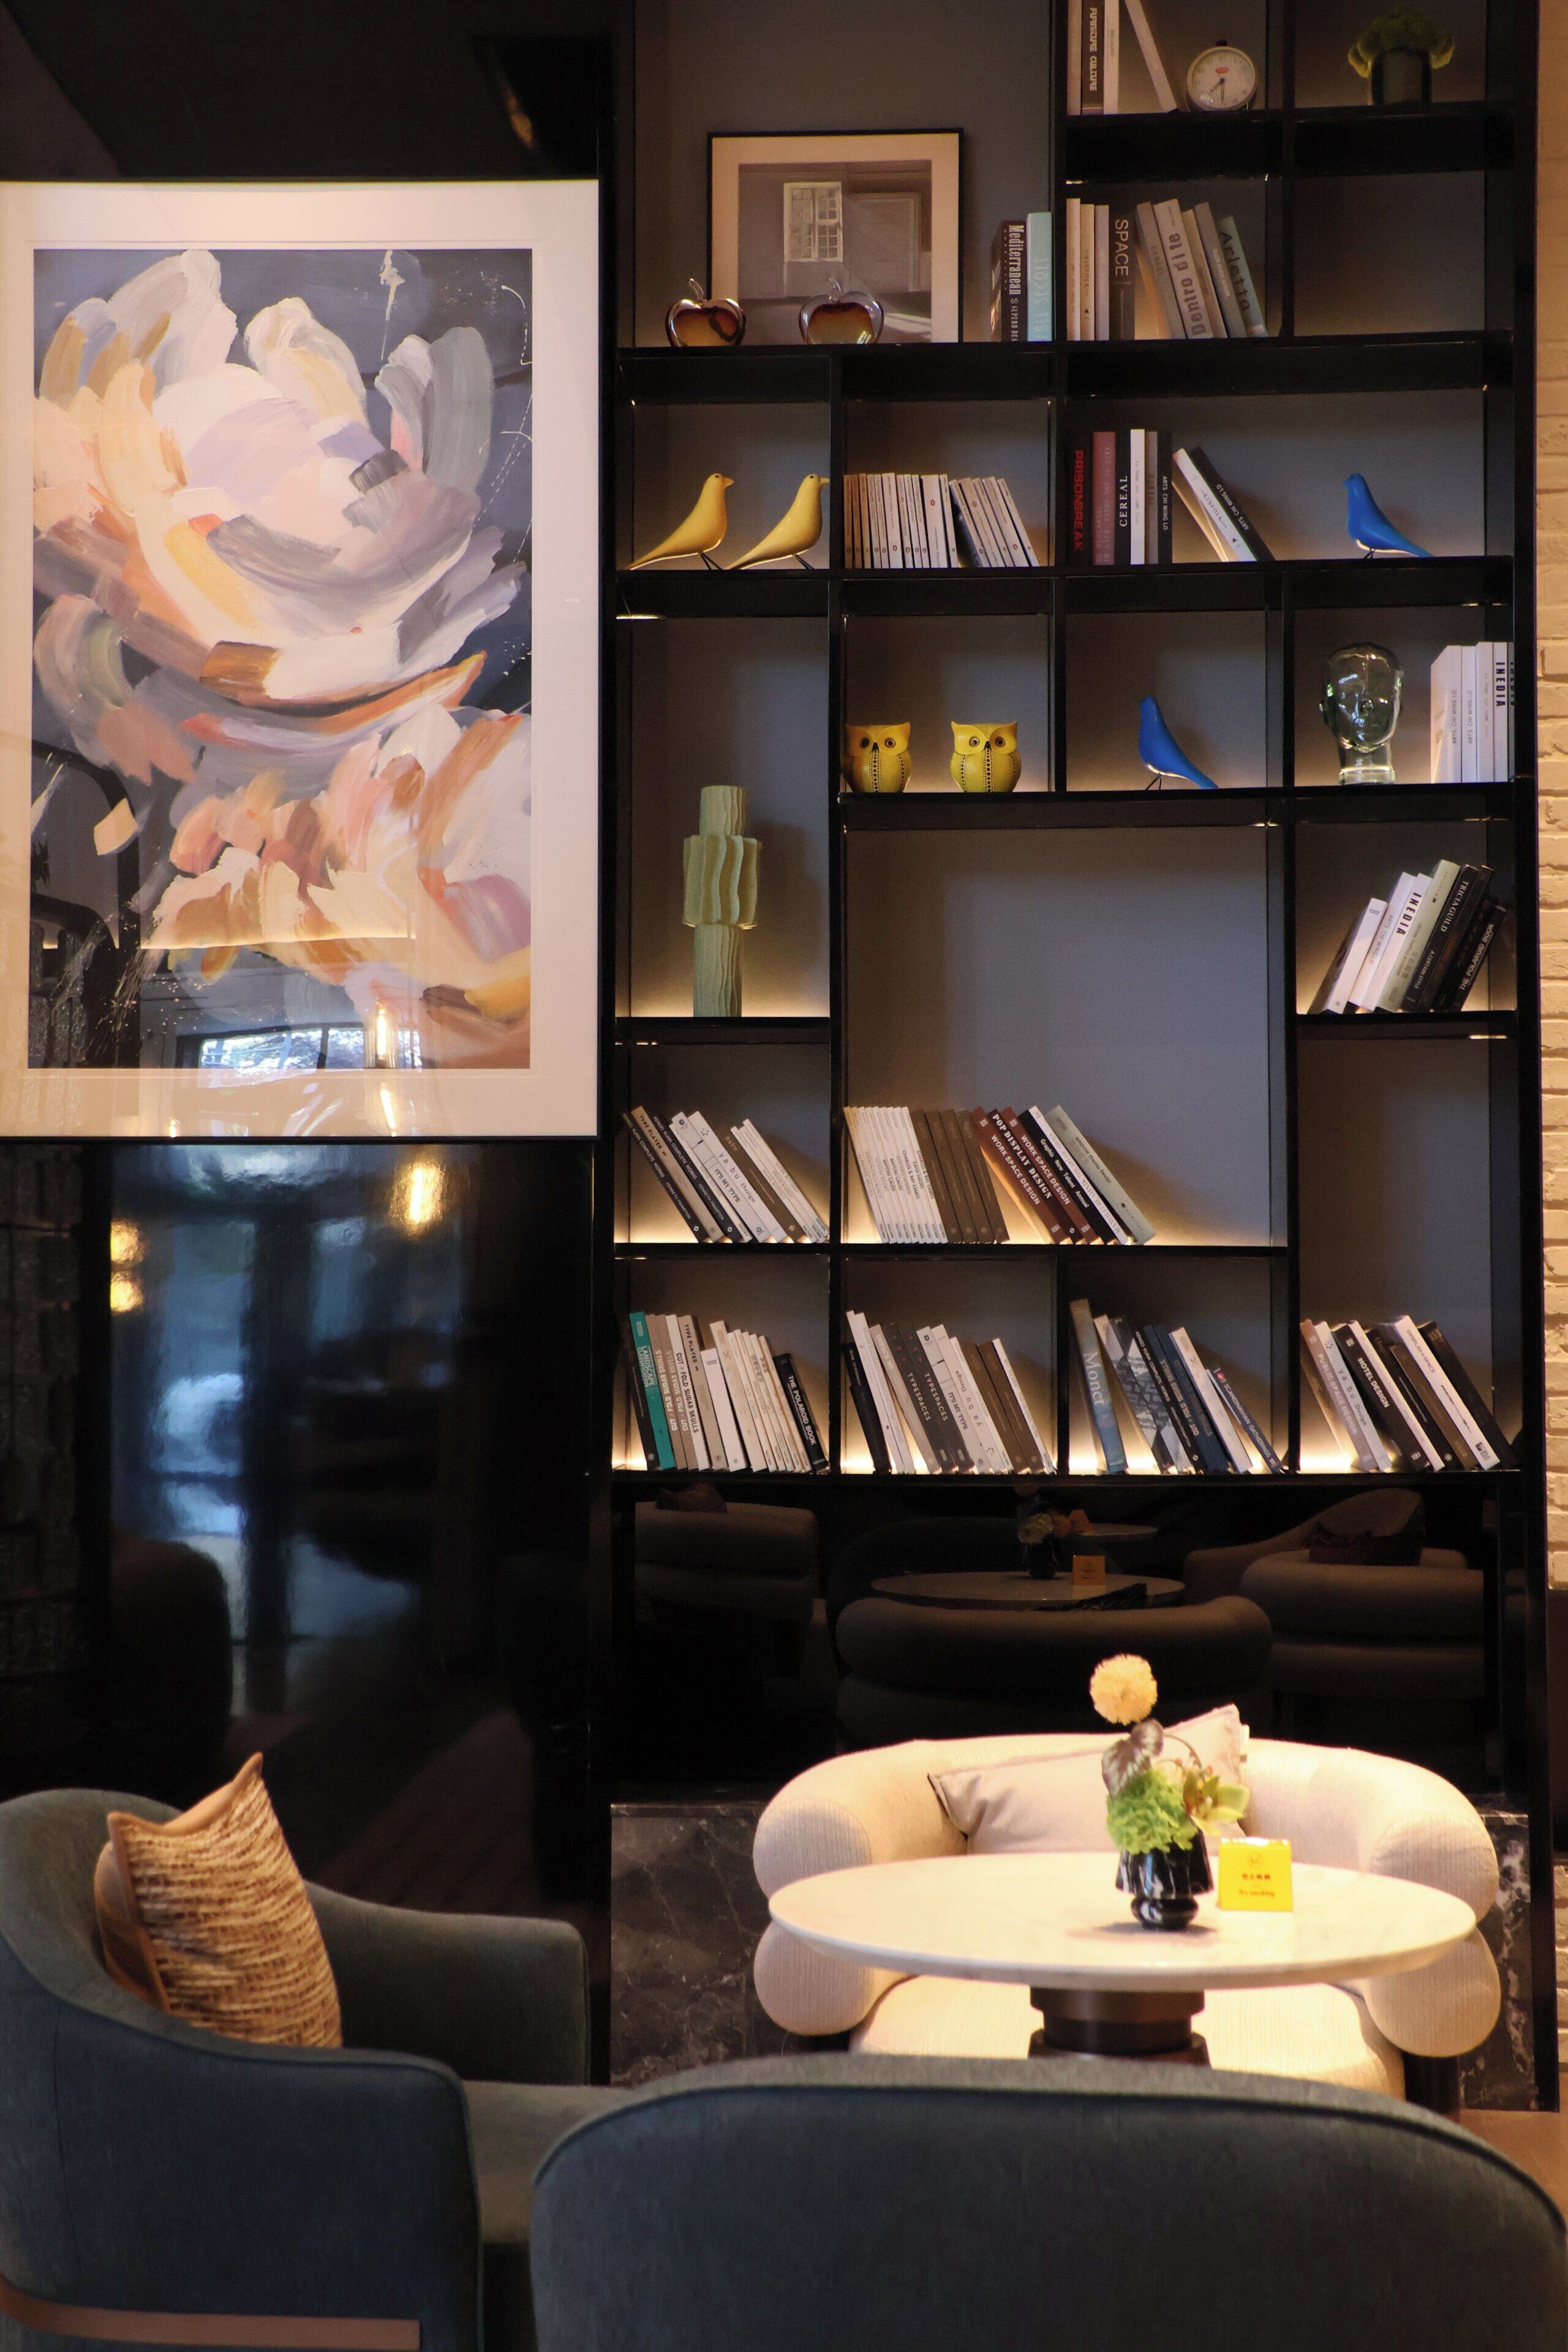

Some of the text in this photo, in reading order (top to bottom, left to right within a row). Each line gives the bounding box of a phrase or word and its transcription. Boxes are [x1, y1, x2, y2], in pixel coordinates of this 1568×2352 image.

[1008, 225, 1024, 295] Mediterranean
[1115, 219, 1128, 276] SPACE
[1217, 228, 1255, 311] Arletta
[1179, 276, 1206, 336] Dentro
[1118, 475, 1128, 527] CEREAL
[1215, 483, 1249, 530] ARTS CHI WING LO
[1496, 662, 1505, 706] INEDIA
[1384, 914, 1393, 929] ARTS
[1396, 891, 1422, 937] INEDIA
[1439, 879, 1469, 933] TRICIA GUILD
[1372, 940, 1382, 956] WING
[1458, 922, 1494, 991] THE POLAROID BOOK
[631, 1127, 642, 1140] KUMA
[639, 1139, 655, 1162] COMPLETE
[652, 1161, 665, 1178] WORKS
[638, 1115, 663, 1149] TYPE PLAYER
[652, 1115, 698, 1180] KENGO KUMA COMPLETE WORKS
[881, 1158, 891, 1176] ANTONI
[888, 1158, 899, 1175] ANTONI
[900, 1150, 911, 1169] CHARLES
[911, 1184, 921, 1199] EAMES
[915, 1149, 927, 1169] CHARLES
[926, 1184, 936, 1199] EAMES
[990, 1134, 1041, 1205] WORK SPACE DESIGN
[992, 1113, 1052, 1199] POP DISPLAY DESIGN
[1020, 1134, 1071, 1205] WORK SPACE DESIGN
[1039, 1137, 1090, 1208] Graphis New Talent Annual
[1099, 1169, 1112, 1184] Design
[721, 1178, 730, 1188] MY
[728, 1188, 741, 1203] TYPE
[739, 1182, 756, 1203] Design
[636, 1346, 649, 1388] CLASSIFICATION
[642, 1346, 655, 1387] LANDSCAPE
[655, 1349, 665, 1373] SKULLS
[687, 1340, 697, 1363] PLAYER
[1406, 1329, 1435, 1373] DISPLAY SPACE
[660, 1374, 669, 1395] SUGAR
[679, 1371, 688, 1387] FOLD
[684, 1389, 693, 1409] SUGAR
[906, 1372, 932, 1421] TYPESPACES
[922, 1372, 949, 1421] TYPESPACES
[954, 1370, 967, 1392] Design
[1082, 1350, 1109, 1407] Monet
[1316, 1352, 1358, 1434] PUBLIC SPACE DESIGN
[1356, 1357, 1390, 1408] HOTEL DESIGN
[665, 1396, 673, 1412] FOLD
[675, 1396, 684, 1412] FOLD
[688, 1410, 699, 1433] SKULLS
[787, 1374, 797, 1389] THE
[792, 1389, 810, 1424] POLAROID
[804, 1425, 816, 1445] BOOK
[952, 1403, 961, 1413] MY
[957, 1413, 969, 1430] TYPE
[1223, 1383, 1272, 1458] SCANDINAVIAN GATHERINGS
[1353, 1403, 1368, 1426] Design
[1189, 1422, 1200, 1436] CUT
